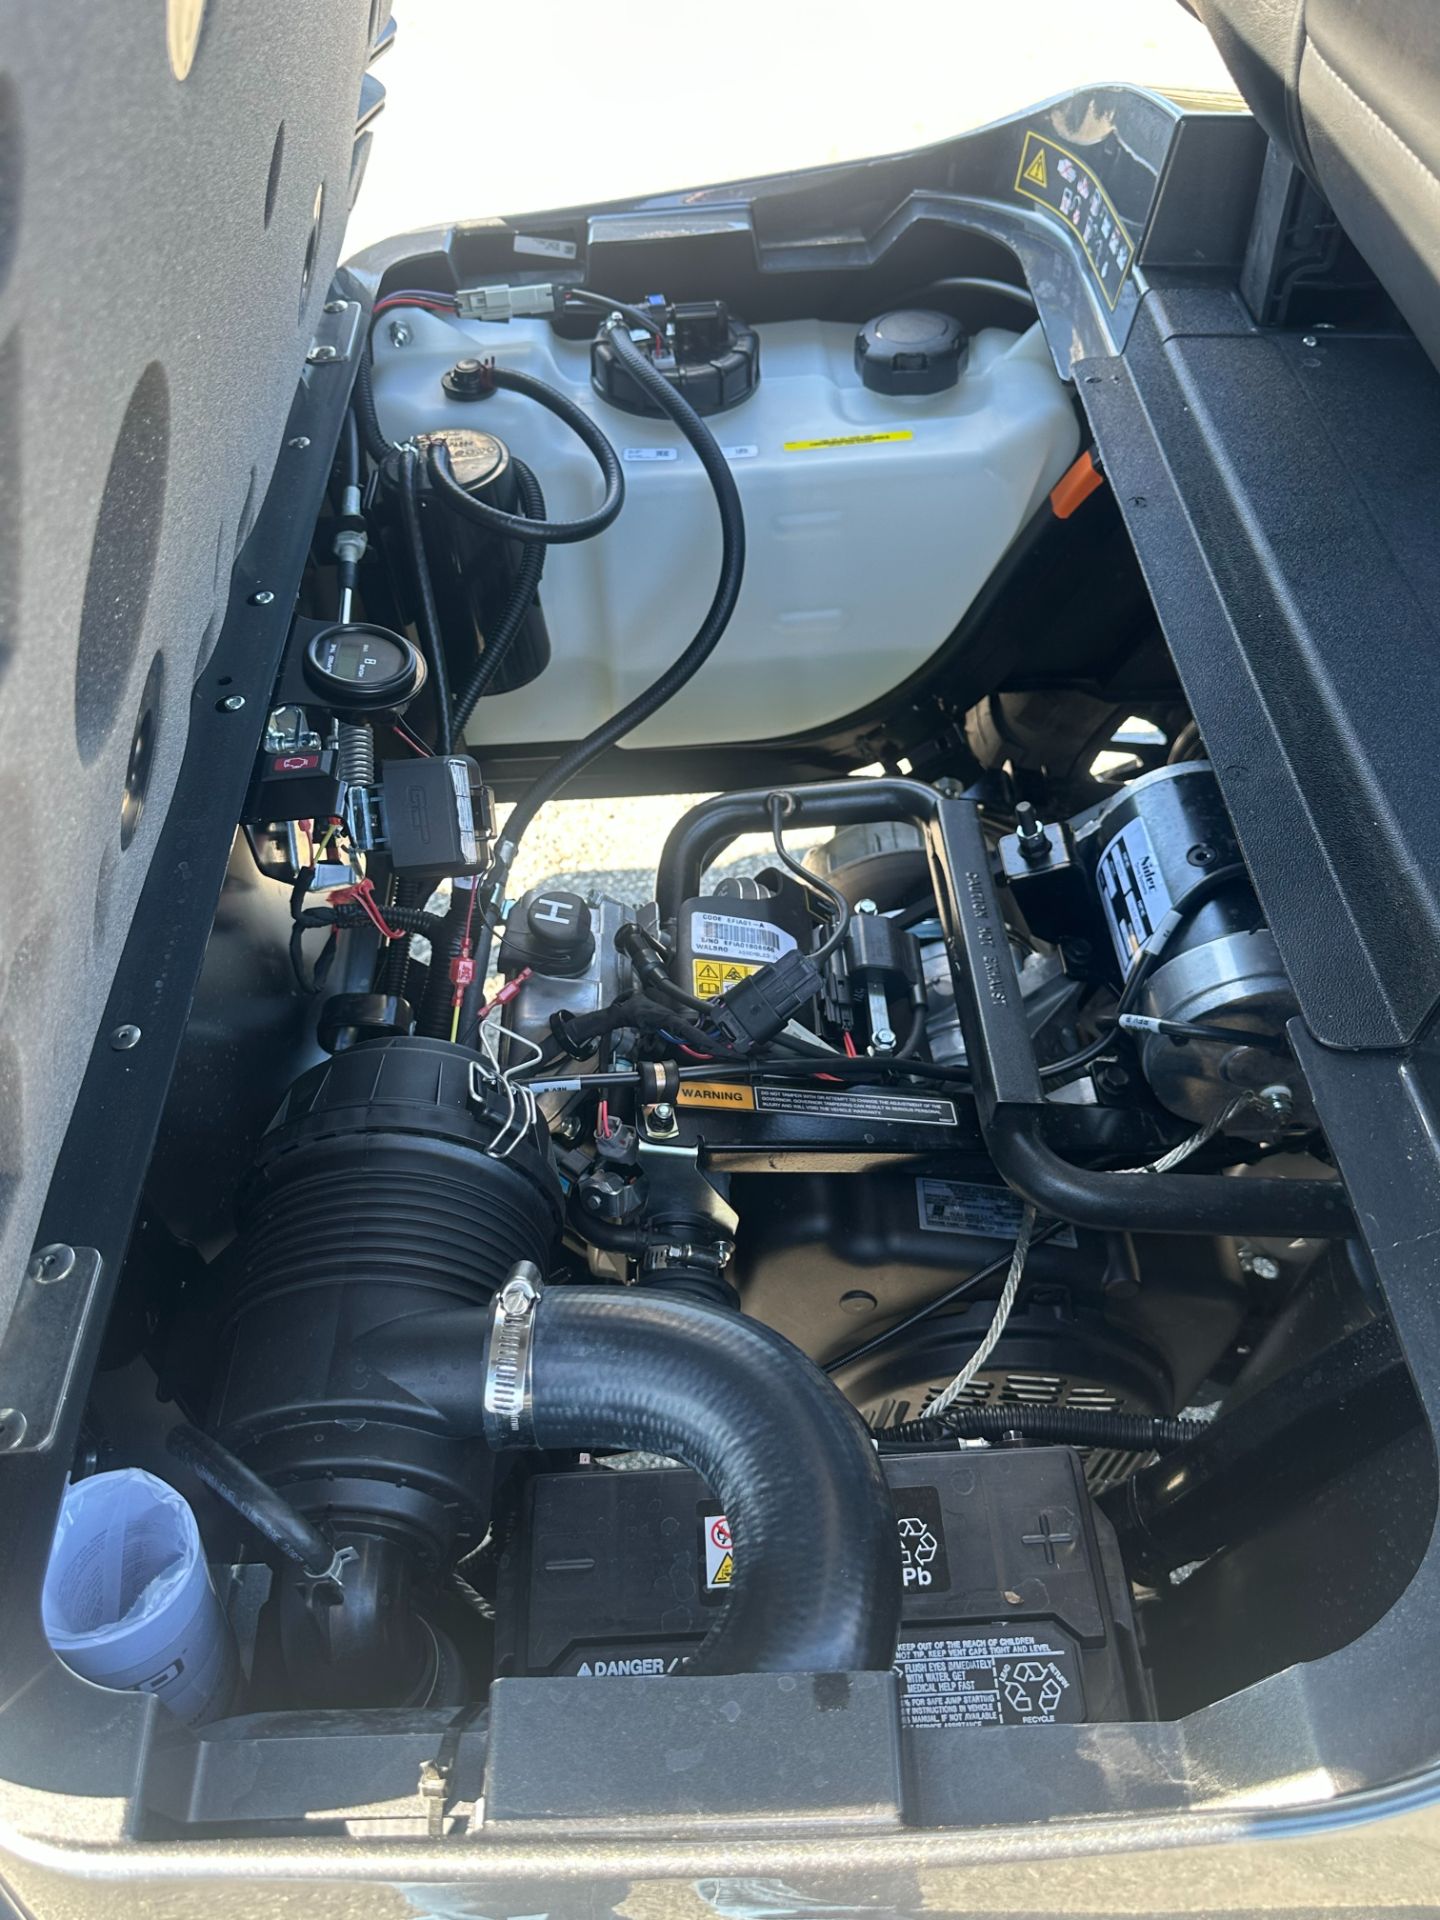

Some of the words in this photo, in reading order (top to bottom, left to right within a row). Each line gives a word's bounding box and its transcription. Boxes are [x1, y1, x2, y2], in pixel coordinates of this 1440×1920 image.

[966, 872, 988, 919] CAUTION
[978, 926, 995, 948] HOT
[696, 943, 729, 953] WALBRO
[984, 955, 1007, 1008] EXHAUST
[682, 1089, 743, 1101] WARNING
[902, 1567, 932, 1587] Pb
[897, 1643, 916, 1651] KEEP
[917, 1642, 933, 1650] OUT
[934, 1641, 945, 1650] OF
[946, 1640, 961, 1649] THE
[962, 1639, 986, 1648] REACH
[987, 1638, 998, 1647] OF
[999, 1636, 1035, 1646] CHILDREN
[928, 1649, 947, 1658] KEEP
[948, 1648, 966, 1657] VENT
[968, 1647, 988, 1656] CAPS
[989, 1645, 1010, 1655] TIGHT
[1012, 1644, 1028, 1653] AND
[594, 1658, 664, 1677] DANGER
[905, 1663, 928, 1674] FLUSH
[928, 1661, 946, 1672] EYES
[948, 1659, 993, 1672] IMMEDIATELY
[906, 1673, 924, 1684] WITH
[952, 1670, 966, 1681] GET
[998, 1663, 1011, 1682] LEAD
[1047, 1662, 1070, 1689] RETURN
[907, 1682, 937, 1693] MEDICAL
[938, 1682, 956, 1692] HELP
[957, 1680, 975, 1690] FAST
[911, 1698, 925, 1706] FOR
[926, 1697, 943, 1706] SAFE
[944, 1696, 962, 1705] JUMP
[963, 1694, 995, 1704] STARTING
[911, 1705, 958, 1715] INSTRUCTIONS
[967, 1703, 994, 1712] VEHICLE
[949, 1713, 963, 1722] NOT
[964, 1711, 997, 1721] AVAILABLE
[1022, 1714, 1056, 1724] RECYCLE
